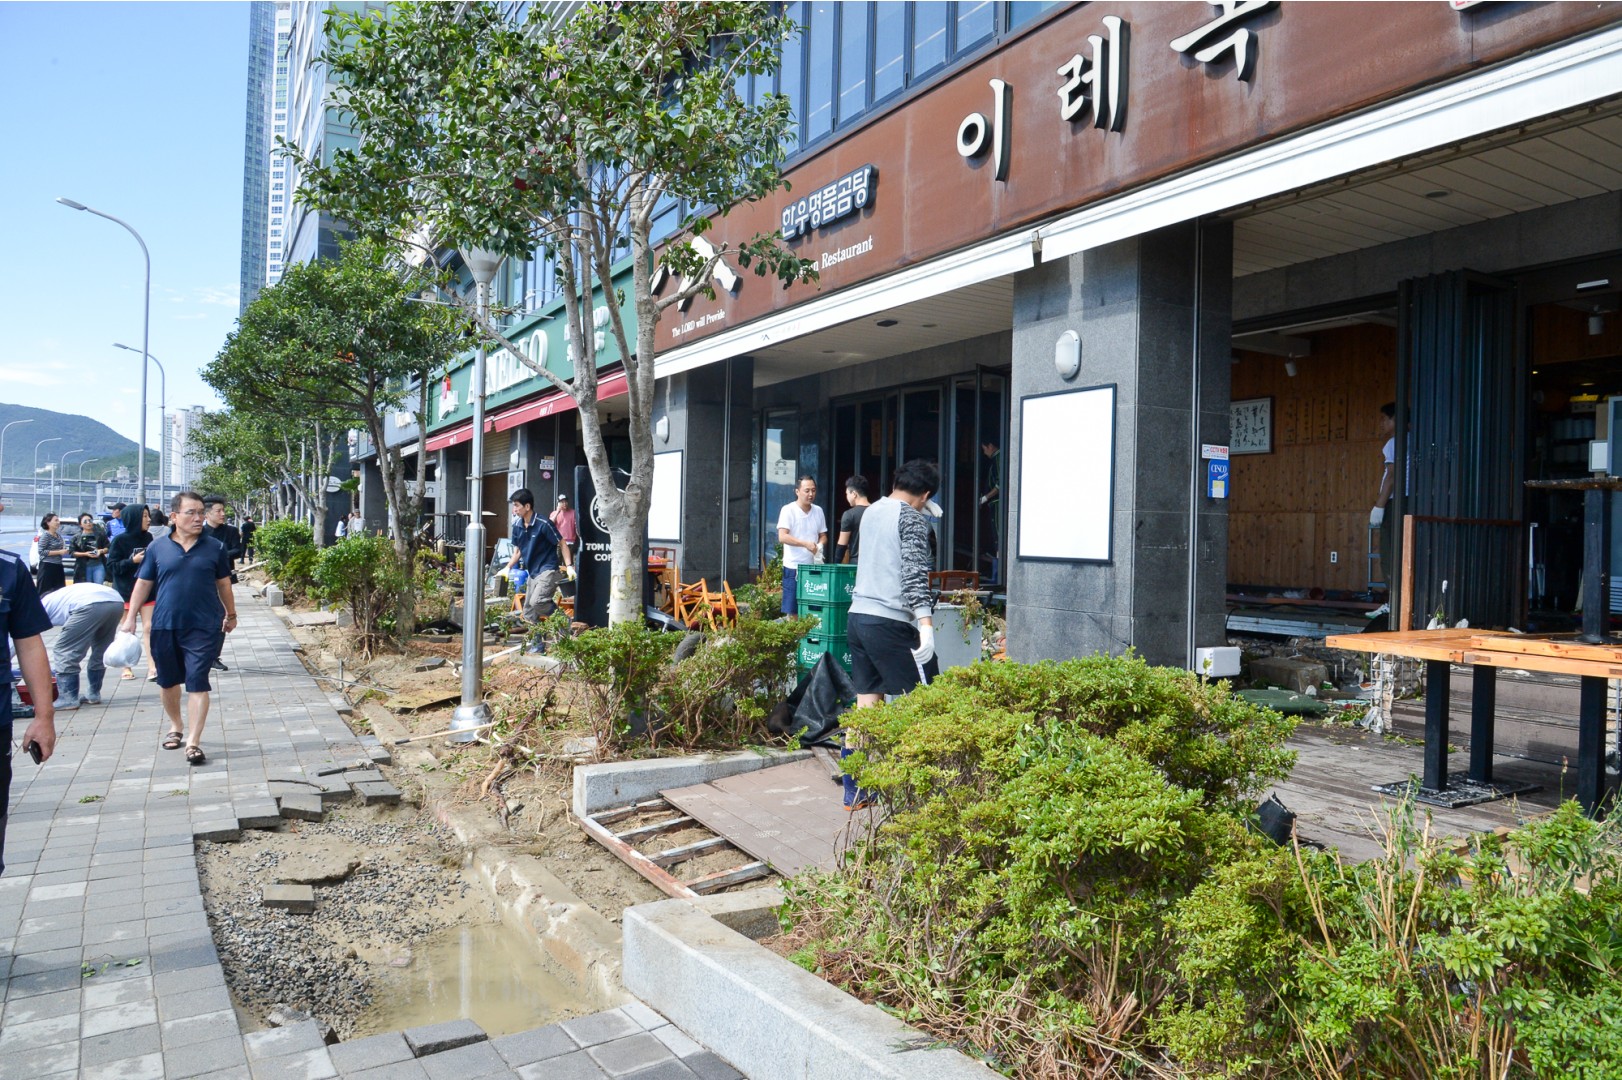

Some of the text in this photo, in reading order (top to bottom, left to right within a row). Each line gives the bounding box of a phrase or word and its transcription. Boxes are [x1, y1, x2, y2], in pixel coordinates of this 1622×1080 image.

[782, 168, 870, 238] 한우명품곰탕
[822, 234, 873, 269] Restaurant
[672, 327, 680, 338] The
[681, 320, 695, 334] LORD
[706, 308, 726, 325] Provide
[585, 542, 604, 551] TOM
